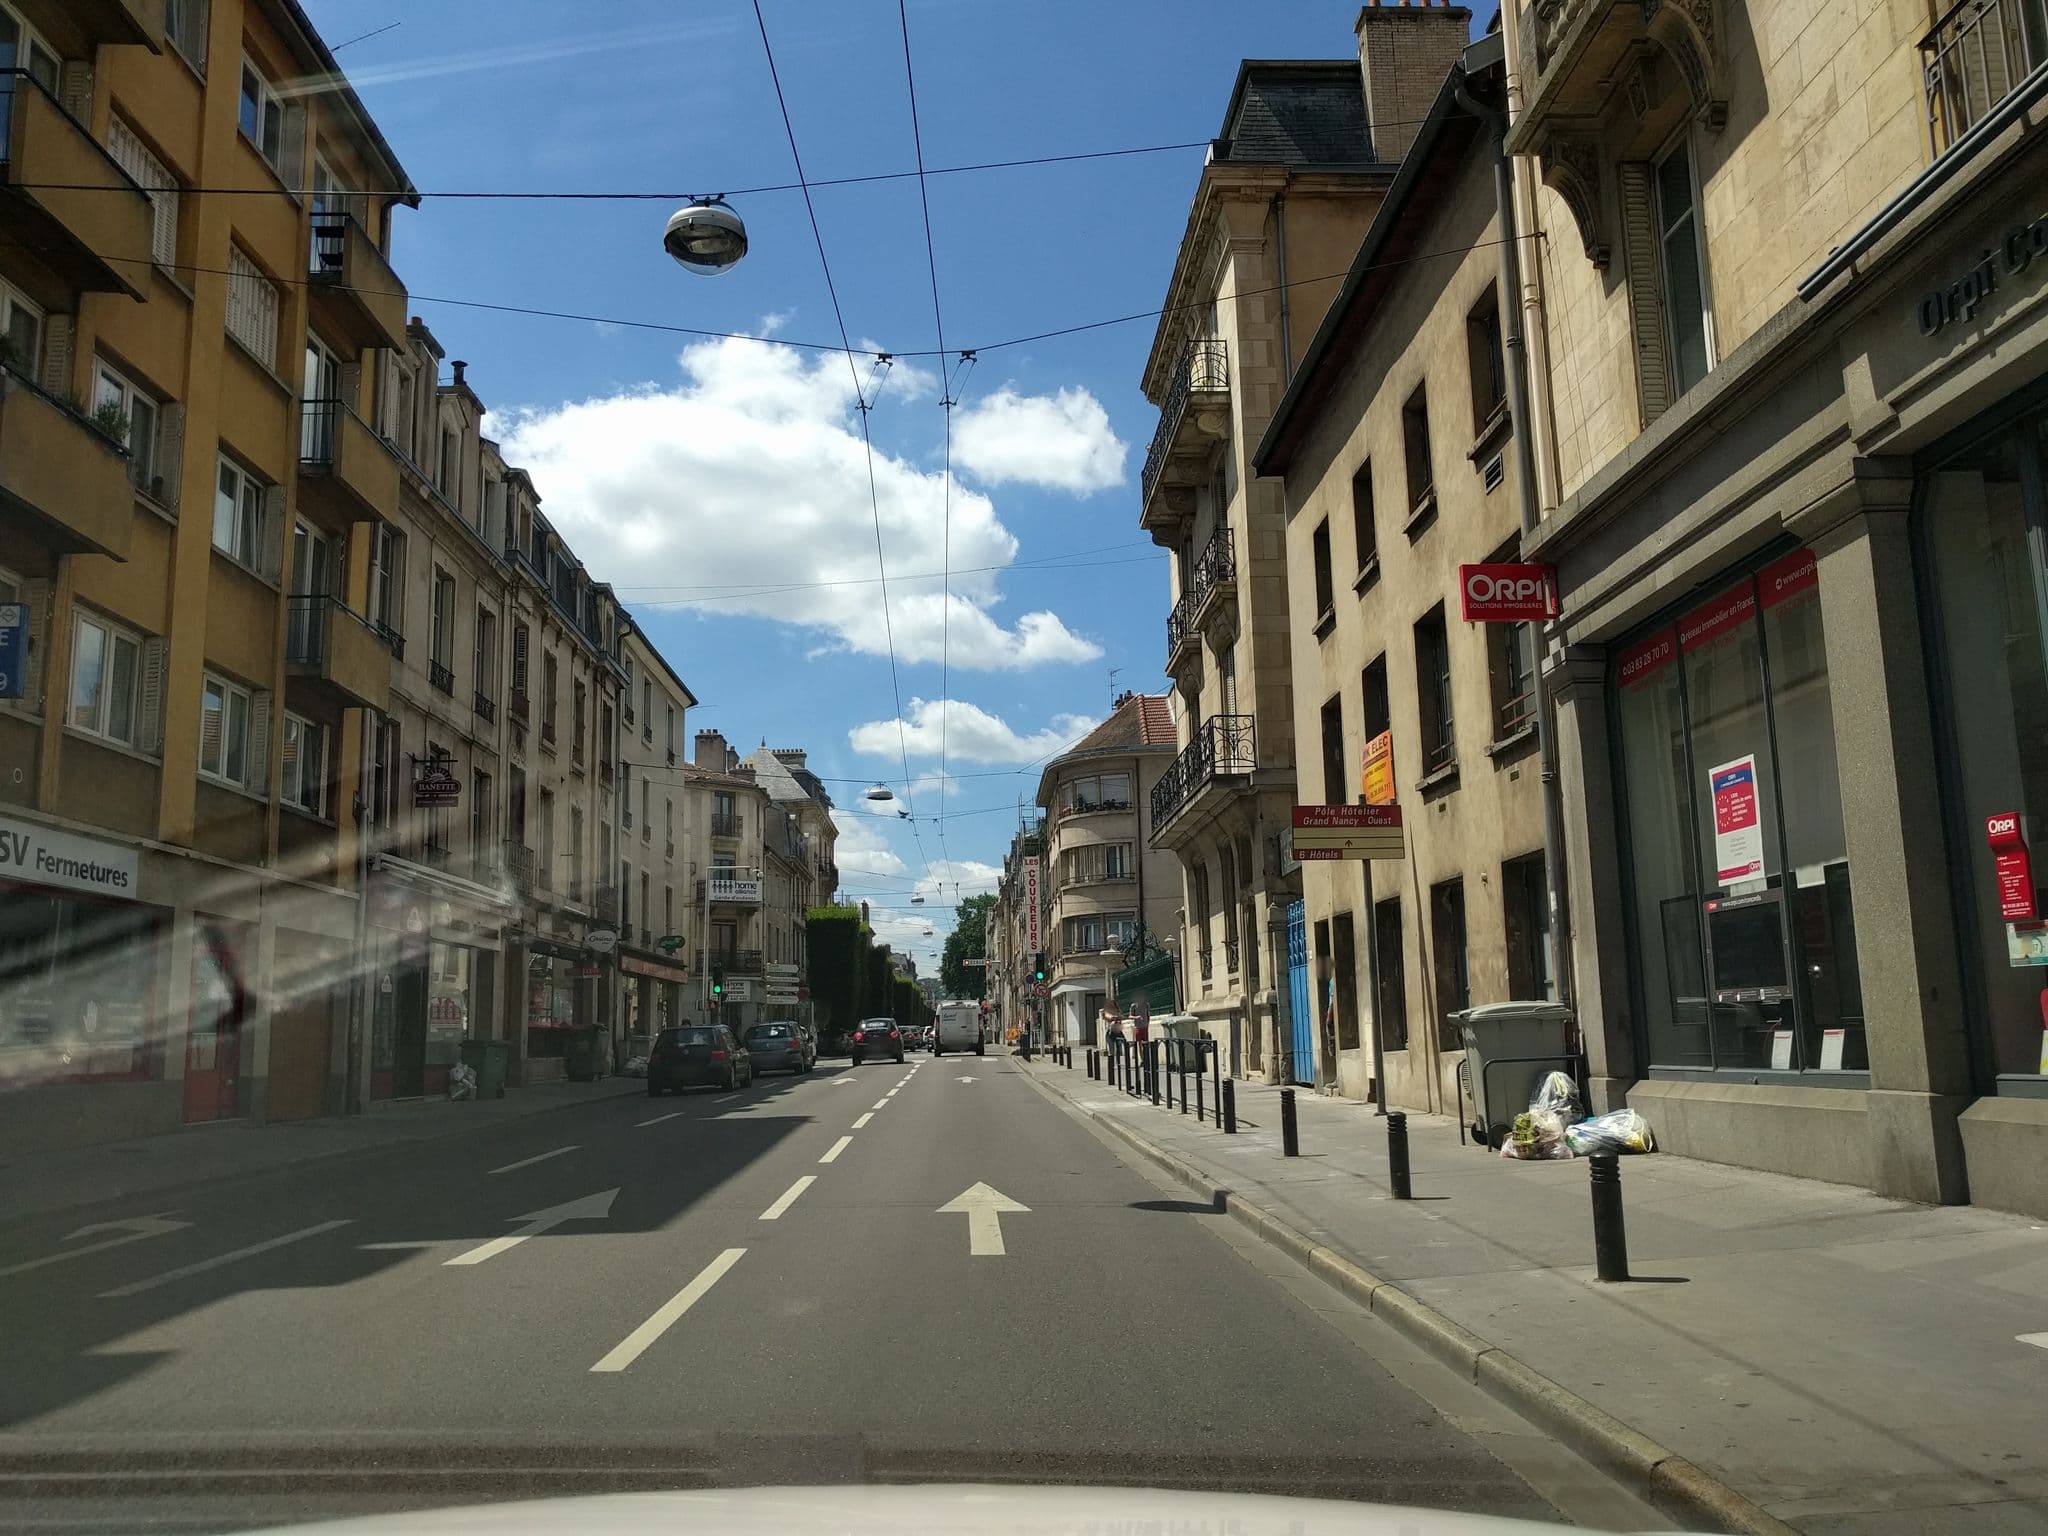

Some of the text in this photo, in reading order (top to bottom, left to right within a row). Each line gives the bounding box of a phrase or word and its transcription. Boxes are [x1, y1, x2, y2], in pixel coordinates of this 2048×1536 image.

[1467, 574, 1543, 602] ORPI
[1315, 807, 1380, 816] Pôle Hôtelier
[1303, 816, 1329, 826] Grand
[1332, 816, 1359, 827] Nancy
[1367, 816, 1392, 825] Ouest
[1988, 818, 2015, 834] ORPI
[1299, 850, 1339, 859] 6 Hôtels
[36, 847, 129, 888] Fermetures
[1024, 858, 1039, 866] LES
[1028, 869, 1038, 950] COUVREURS
